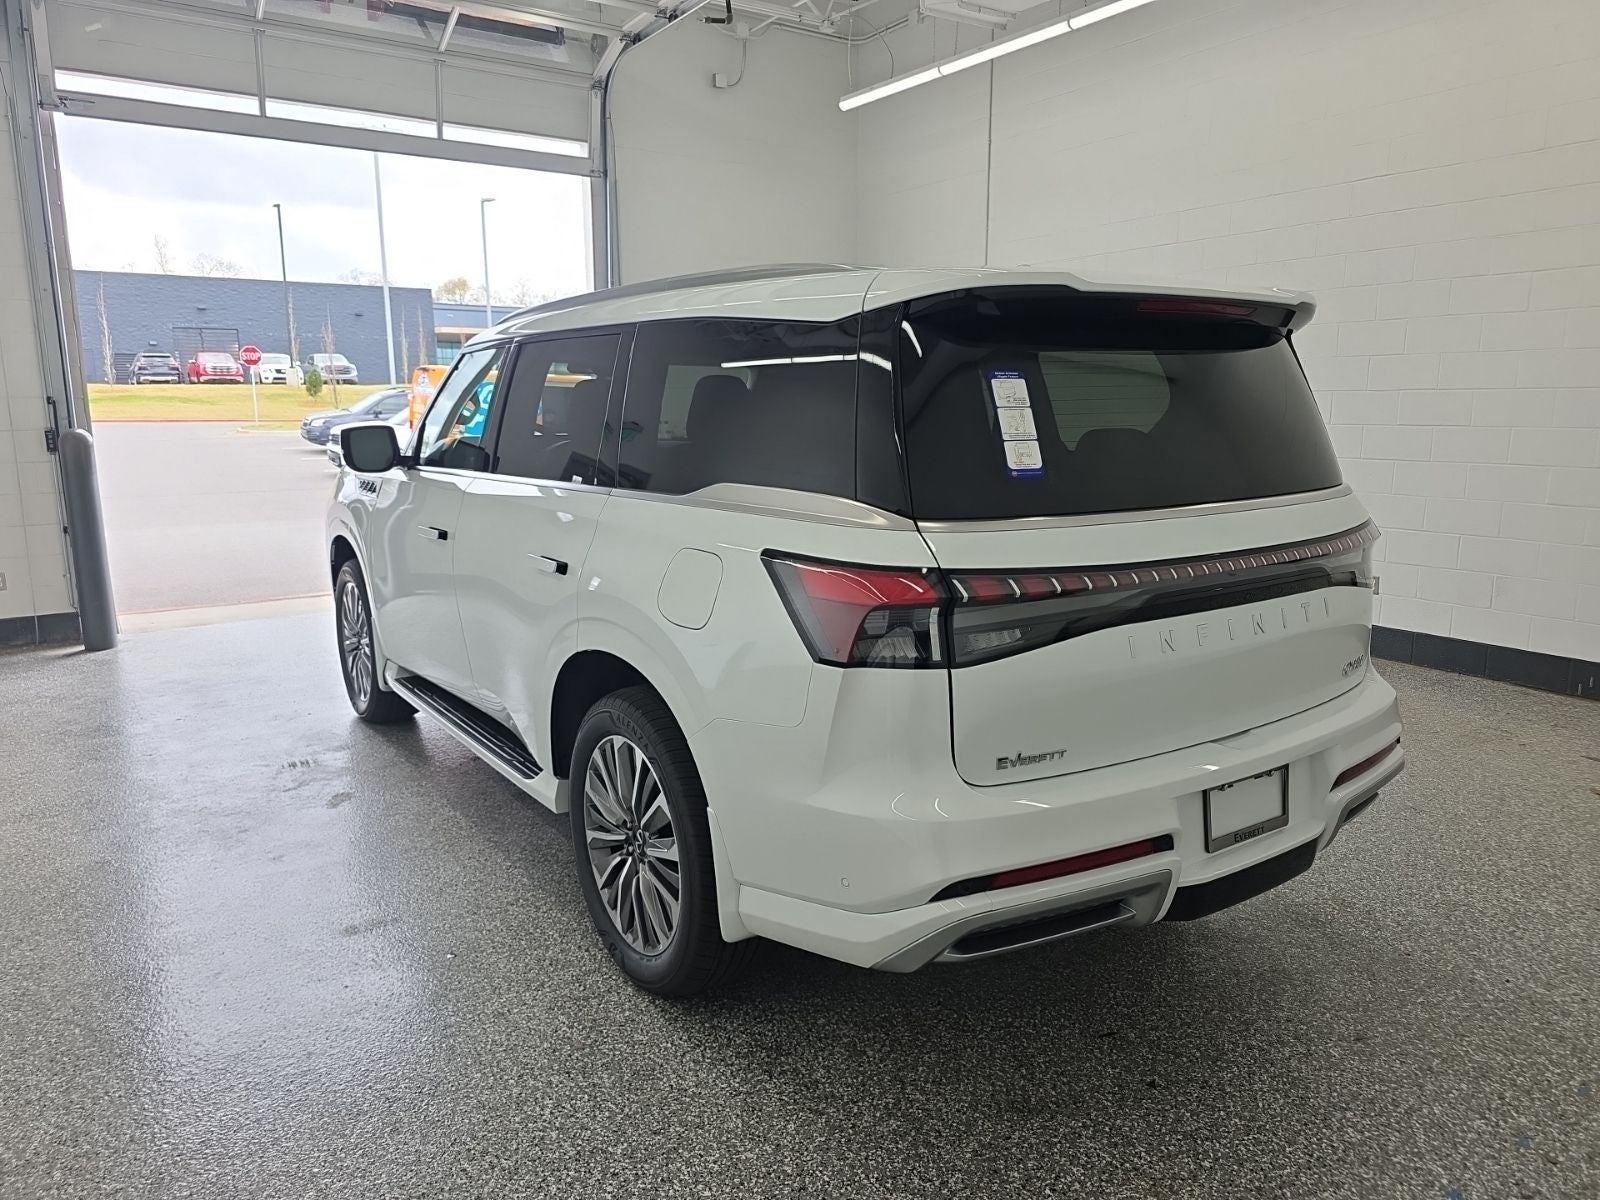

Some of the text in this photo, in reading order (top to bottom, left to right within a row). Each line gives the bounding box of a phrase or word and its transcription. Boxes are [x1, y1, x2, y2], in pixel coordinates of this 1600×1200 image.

[241, 352, 260, 360] STOP
[1128, 595, 1330, 659] INFINITI
[615, 713, 649, 753] ALENZA
